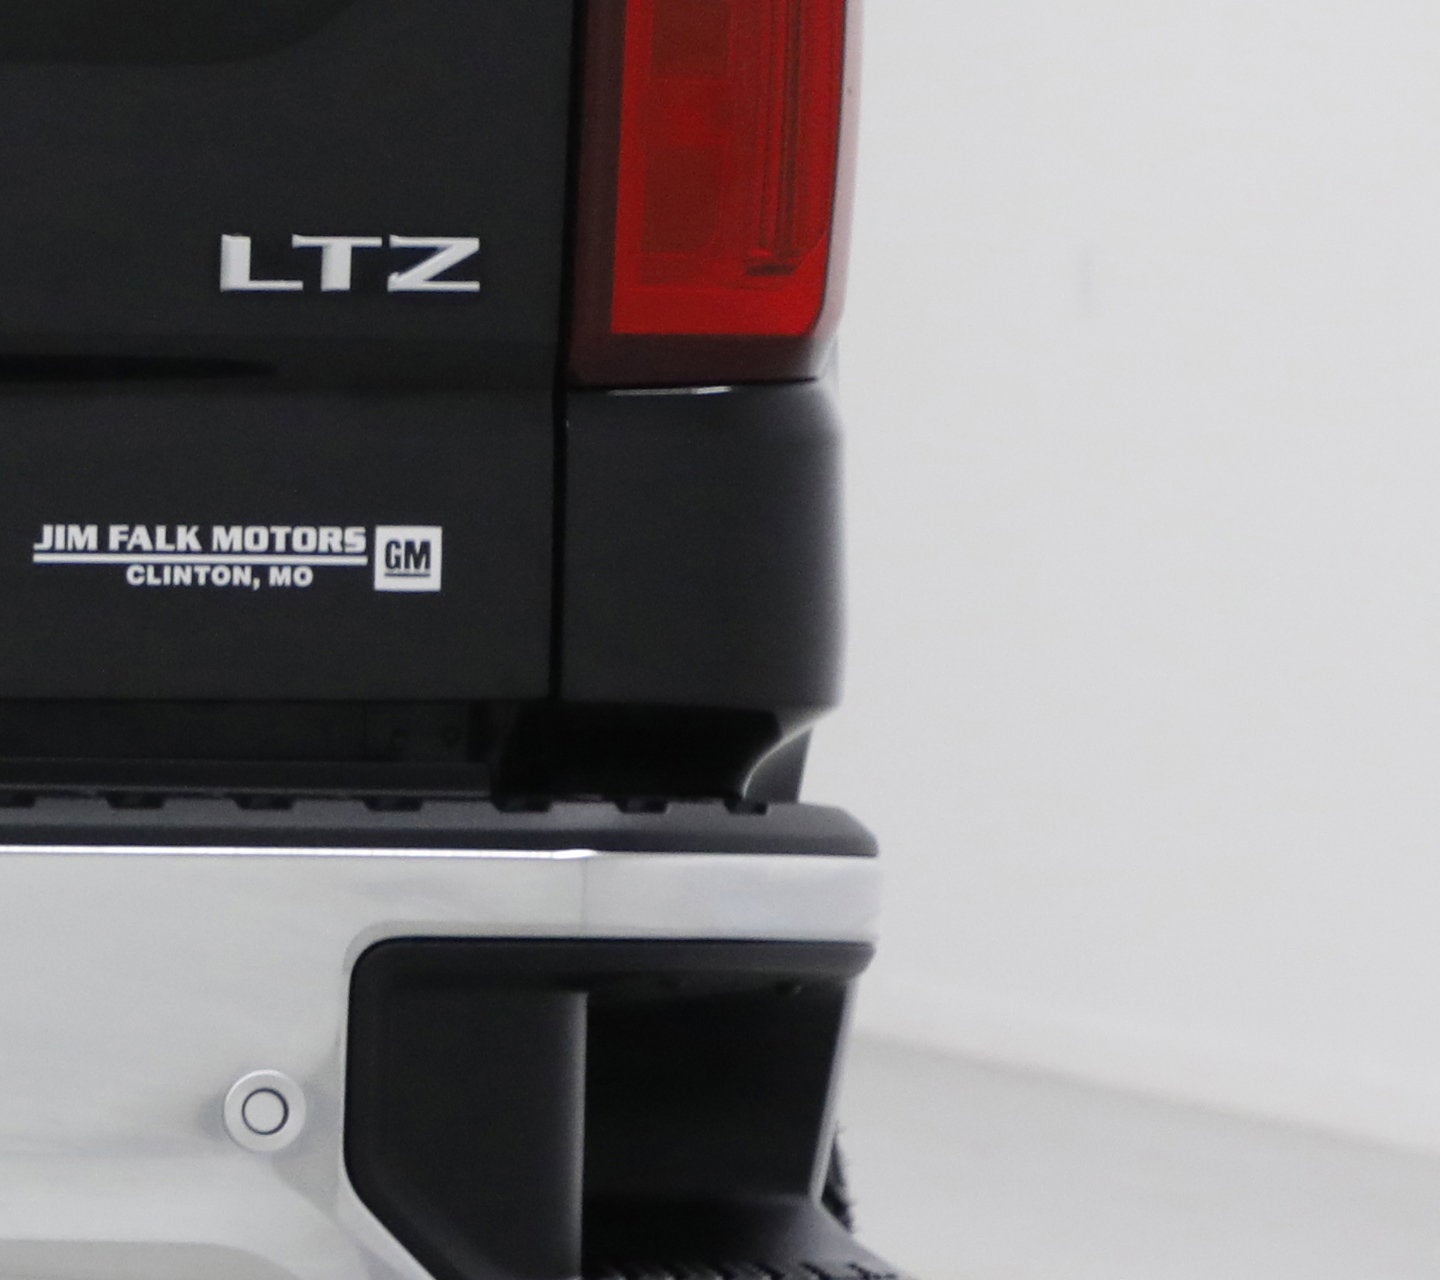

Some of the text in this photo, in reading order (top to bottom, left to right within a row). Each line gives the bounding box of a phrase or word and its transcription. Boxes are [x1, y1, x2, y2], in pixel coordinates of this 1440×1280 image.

[220, 234, 480, 292] LTZ
[33, 524, 367, 553] JIM FALK MOTORS
[384, 539, 432, 571] GM
[126, 565, 314, 591] CLINTON, MO
